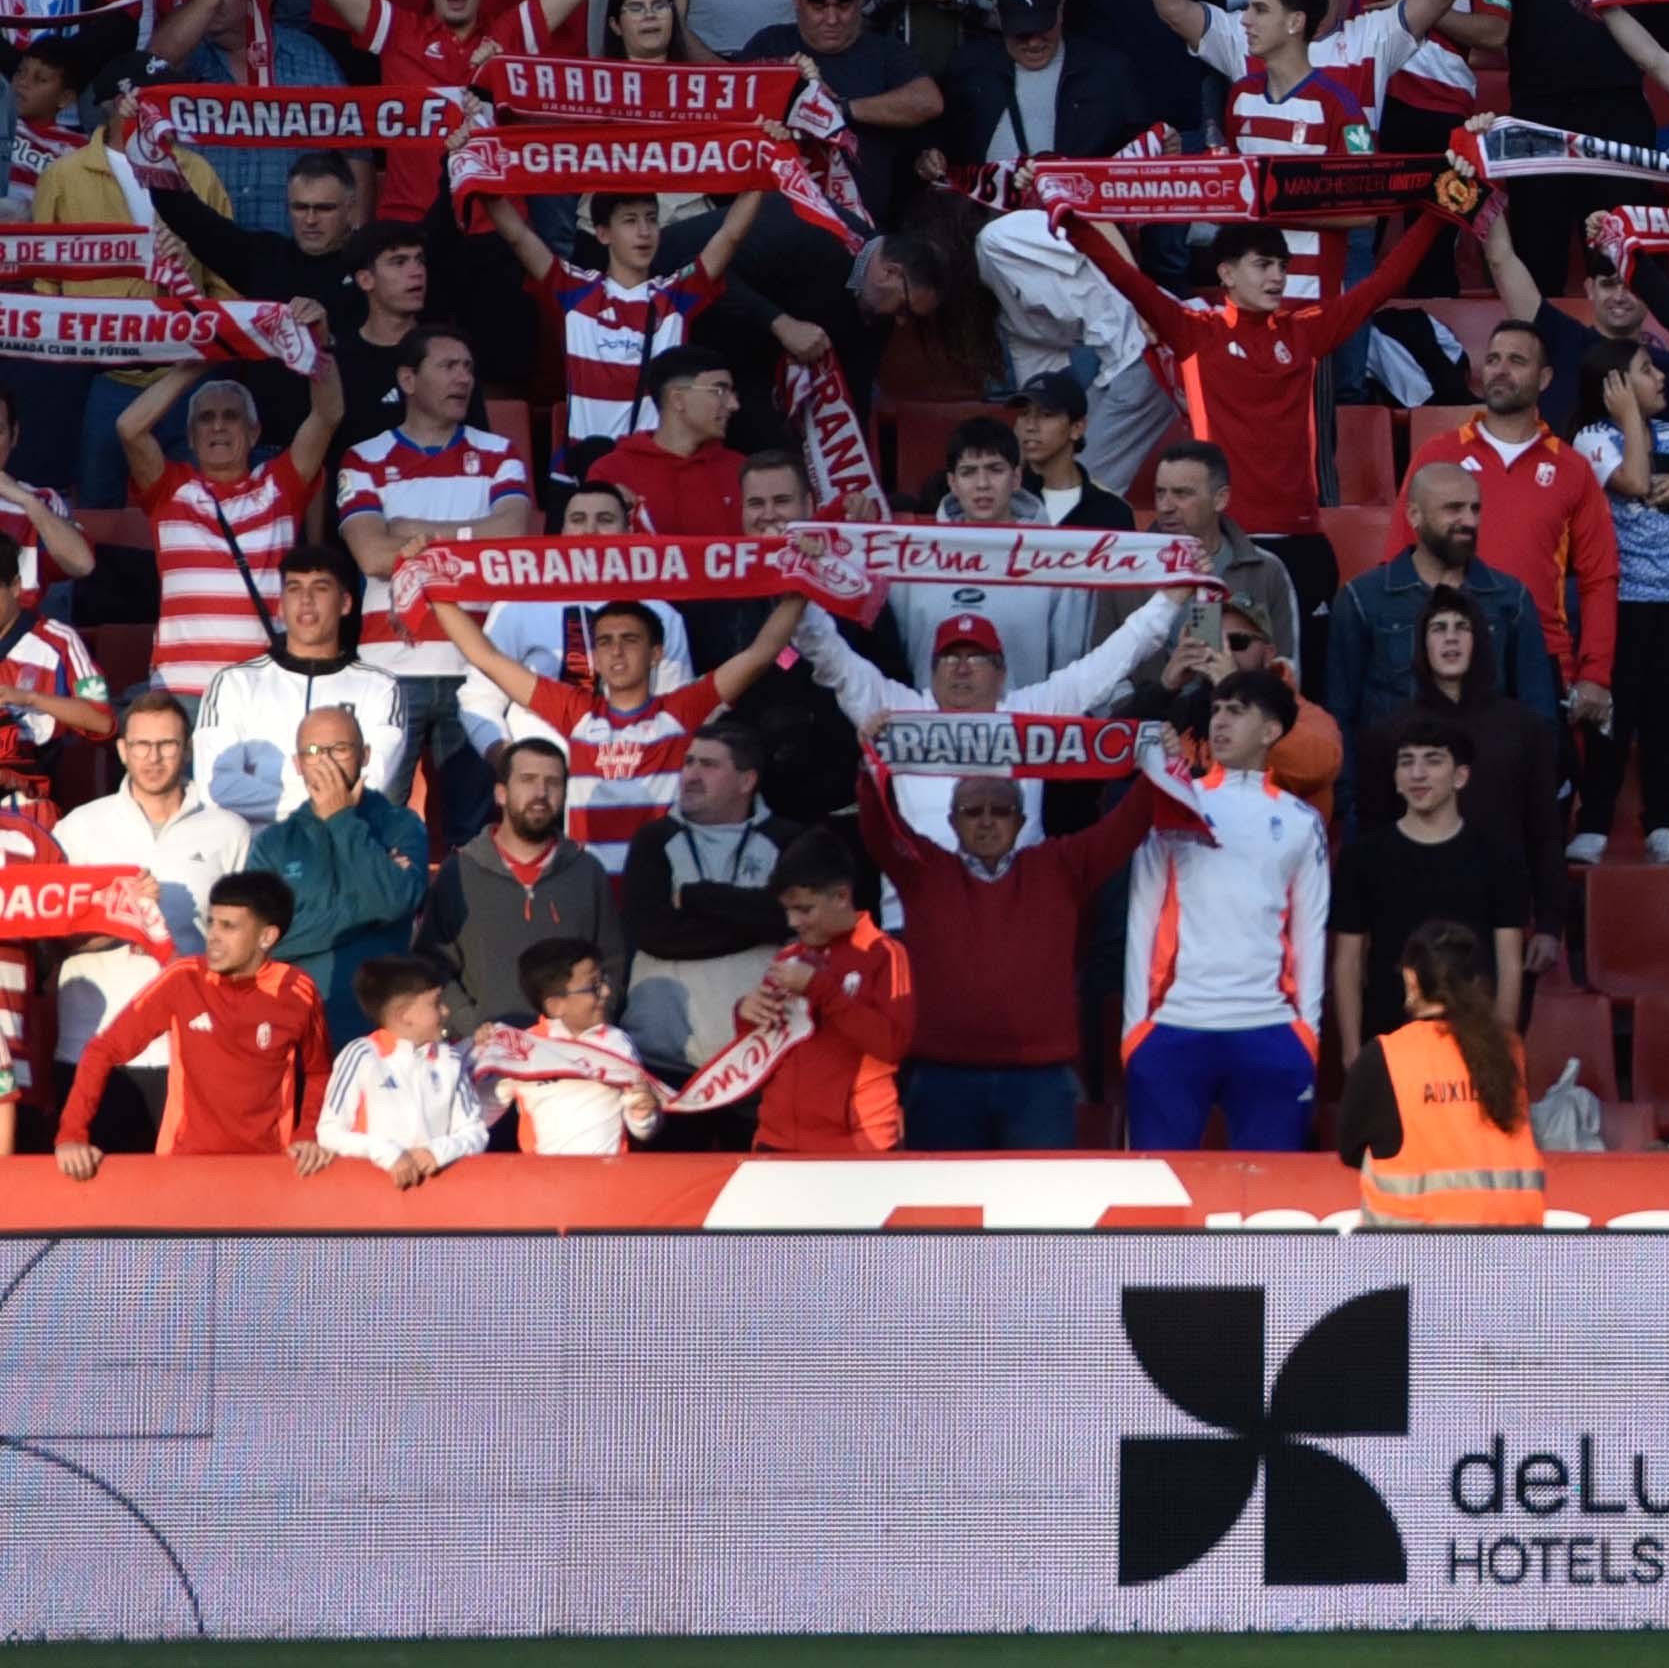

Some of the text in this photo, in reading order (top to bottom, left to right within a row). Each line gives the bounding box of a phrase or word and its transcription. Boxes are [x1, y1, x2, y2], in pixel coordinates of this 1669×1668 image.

[667, 71, 758, 110] 1931
[171, 98, 450, 138] GRANADA C.F.
[609, 106, 644, 120] CLUB
[1283, 175, 1386, 196] MANCHESTER
[16, 235, 142, 263] DE FÚTBOL
[58, 310, 216, 343] ETERNOS
[48, 342, 78, 357] CLUB
[481, 541, 758, 585] GRANADA CF
[865, 530, 1146, 578] Eterna Lucha
[874, 722, 1087, 765] GRANADA
[1447, 1536, 1666, 1587] HOTELS
